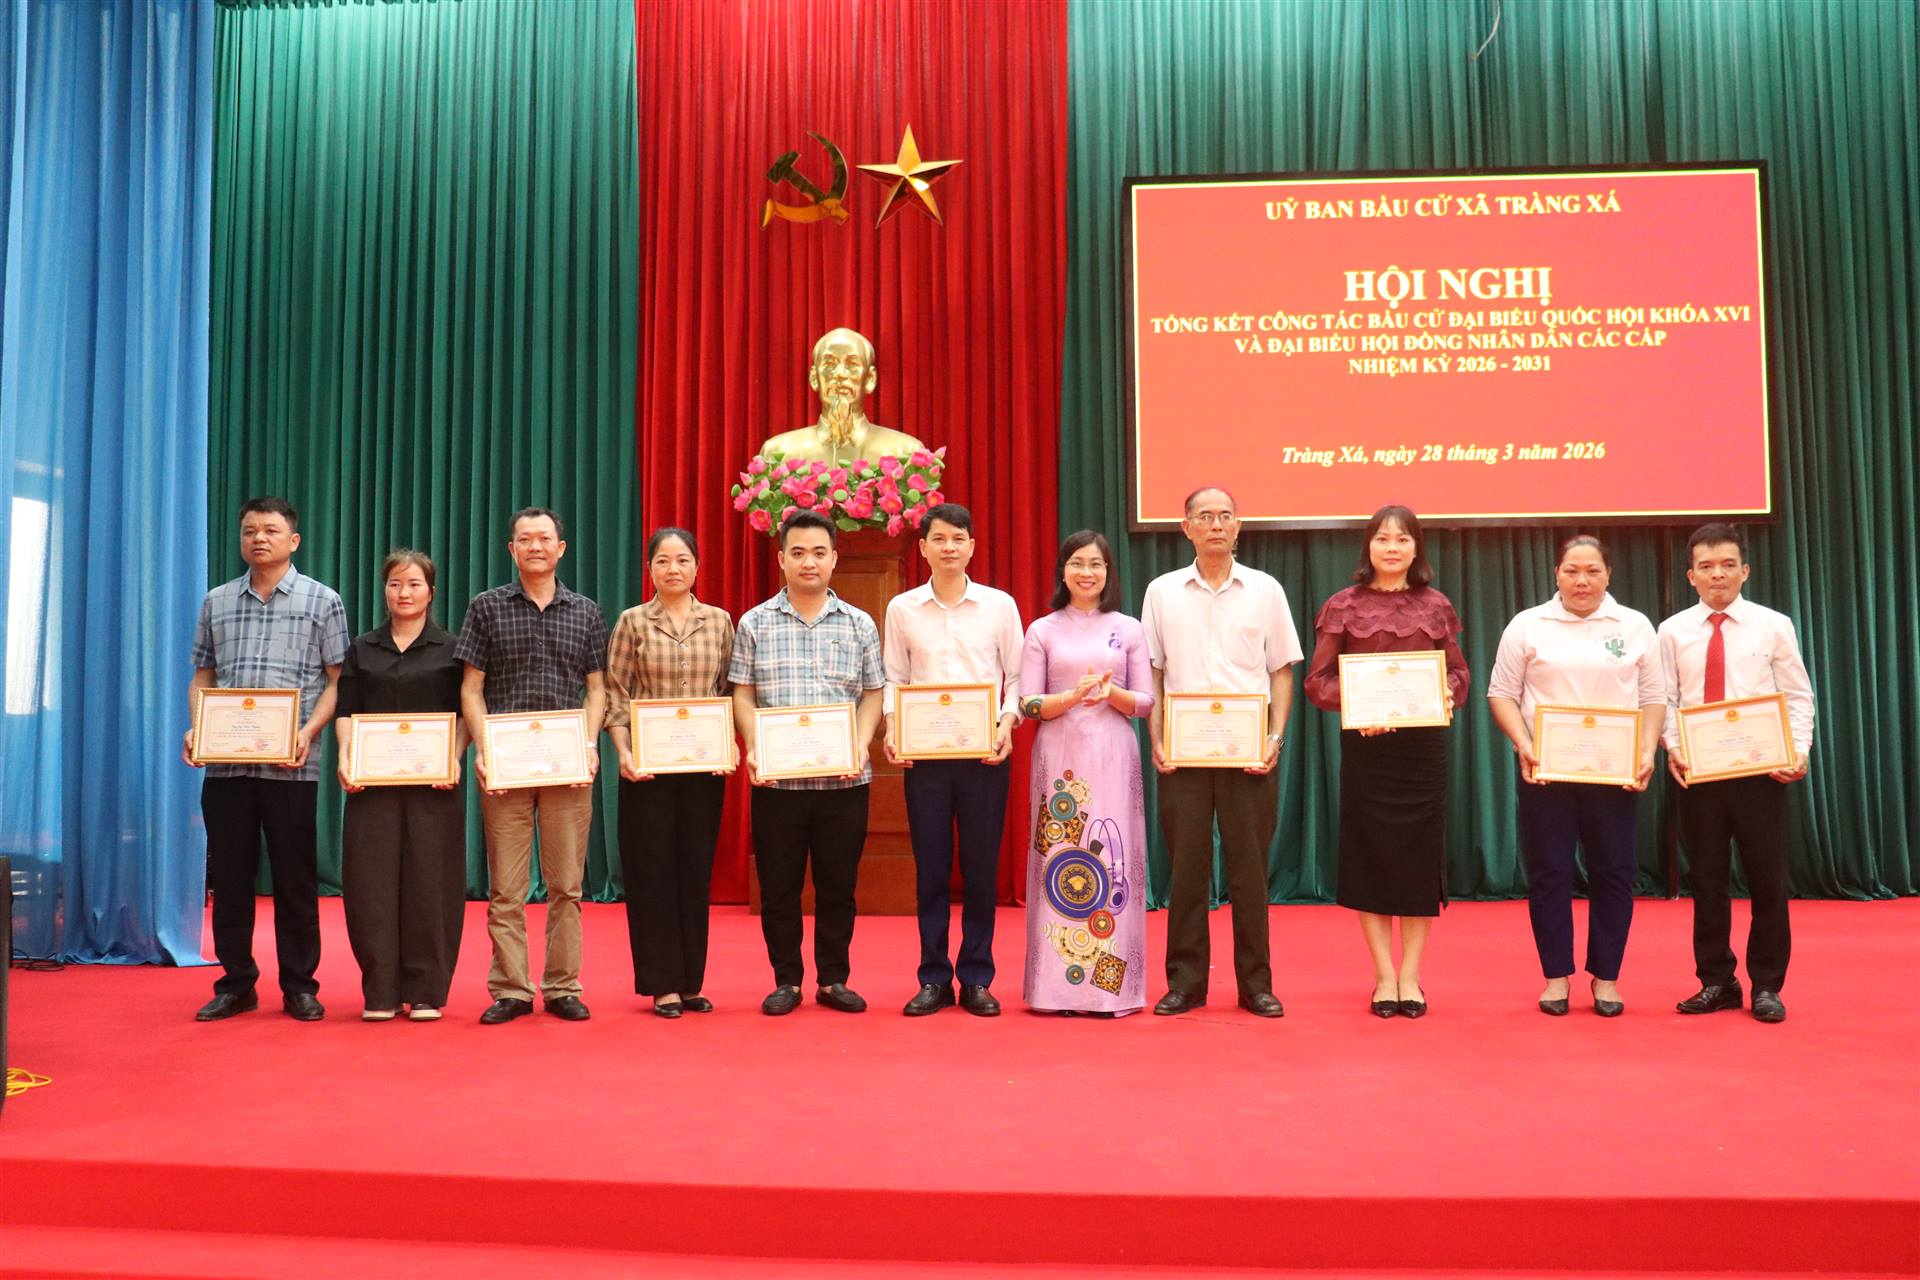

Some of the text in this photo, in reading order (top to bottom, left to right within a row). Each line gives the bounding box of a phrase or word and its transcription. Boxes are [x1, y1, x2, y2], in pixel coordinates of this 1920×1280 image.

[1305, 200, 1354, 219] BAN
[1456, 193, 1490, 216] XÃ
[1495, 192, 1581, 215] TRÀNG
[1587, 189, 1621, 213] XÁ
[1344, 265, 1552, 309] HỘI NGHỊ
[1258, 310, 1317, 331] CÔNG
[1321, 309, 1363, 330] TÁC
[1448, 310, 1484, 331] ĐẠI
[1606, 305, 1644, 328] HỘI
[1650, 303, 1709, 324] KHÓA
[1714, 305, 1750, 322] XVI
[1234, 334, 1263, 354] VÀ
[1268, 336, 1303, 357] ĐẠI
[1361, 333, 1398, 355] HỘI
[1468, 330, 1525, 350] NHÂN
[1530, 329, 1573, 349] DÂN
[1577, 328, 1621, 347] CÁC
[1349, 357, 1417, 378] NHIỆM
[1456, 356, 1497, 372] 2026
[1512, 355, 1551, 372] 2031
[1282, 442, 1606, 468] Tràng Xá, ngày 28 tháng 3 năm 2026
